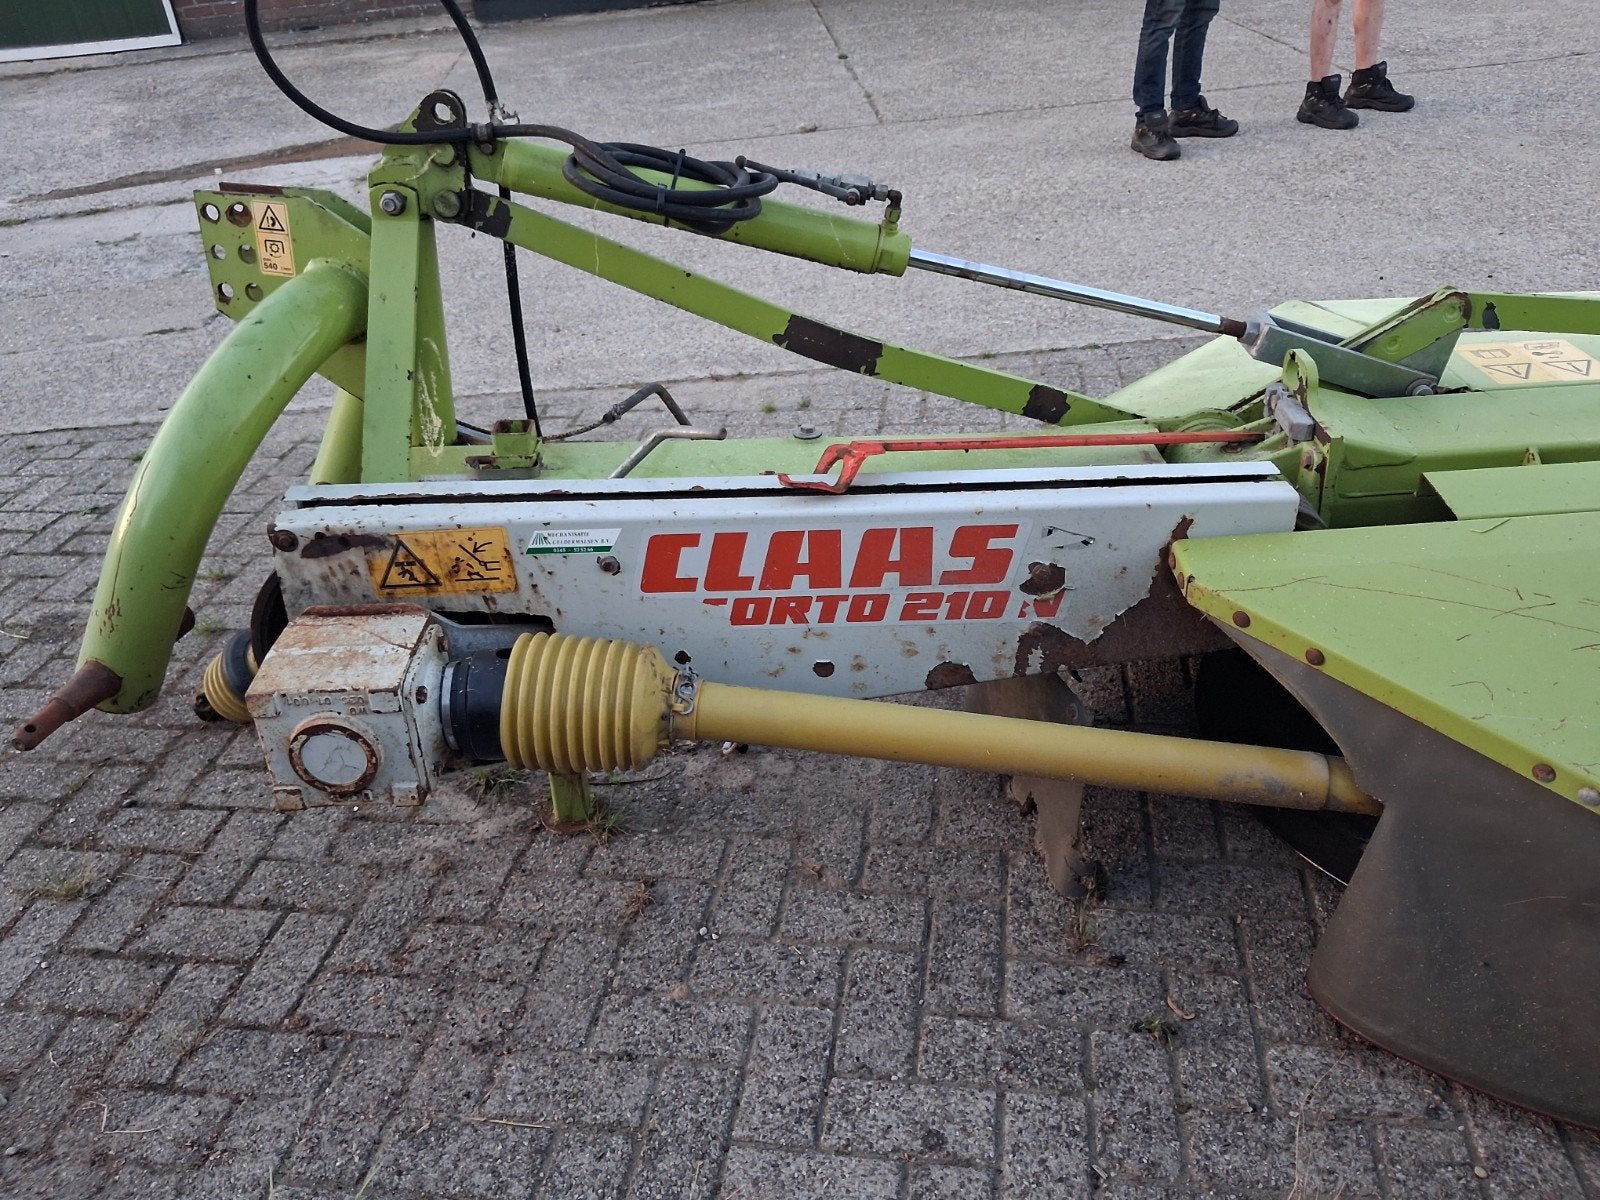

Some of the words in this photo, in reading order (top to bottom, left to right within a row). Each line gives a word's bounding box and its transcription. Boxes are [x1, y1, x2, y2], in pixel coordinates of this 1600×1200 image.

[264, 262, 278, 270] 540
[640, 524, 1020, 593] CLAAS
[703, 593, 892, 626] ORTO
[899, 590, 1012, 621] 210
